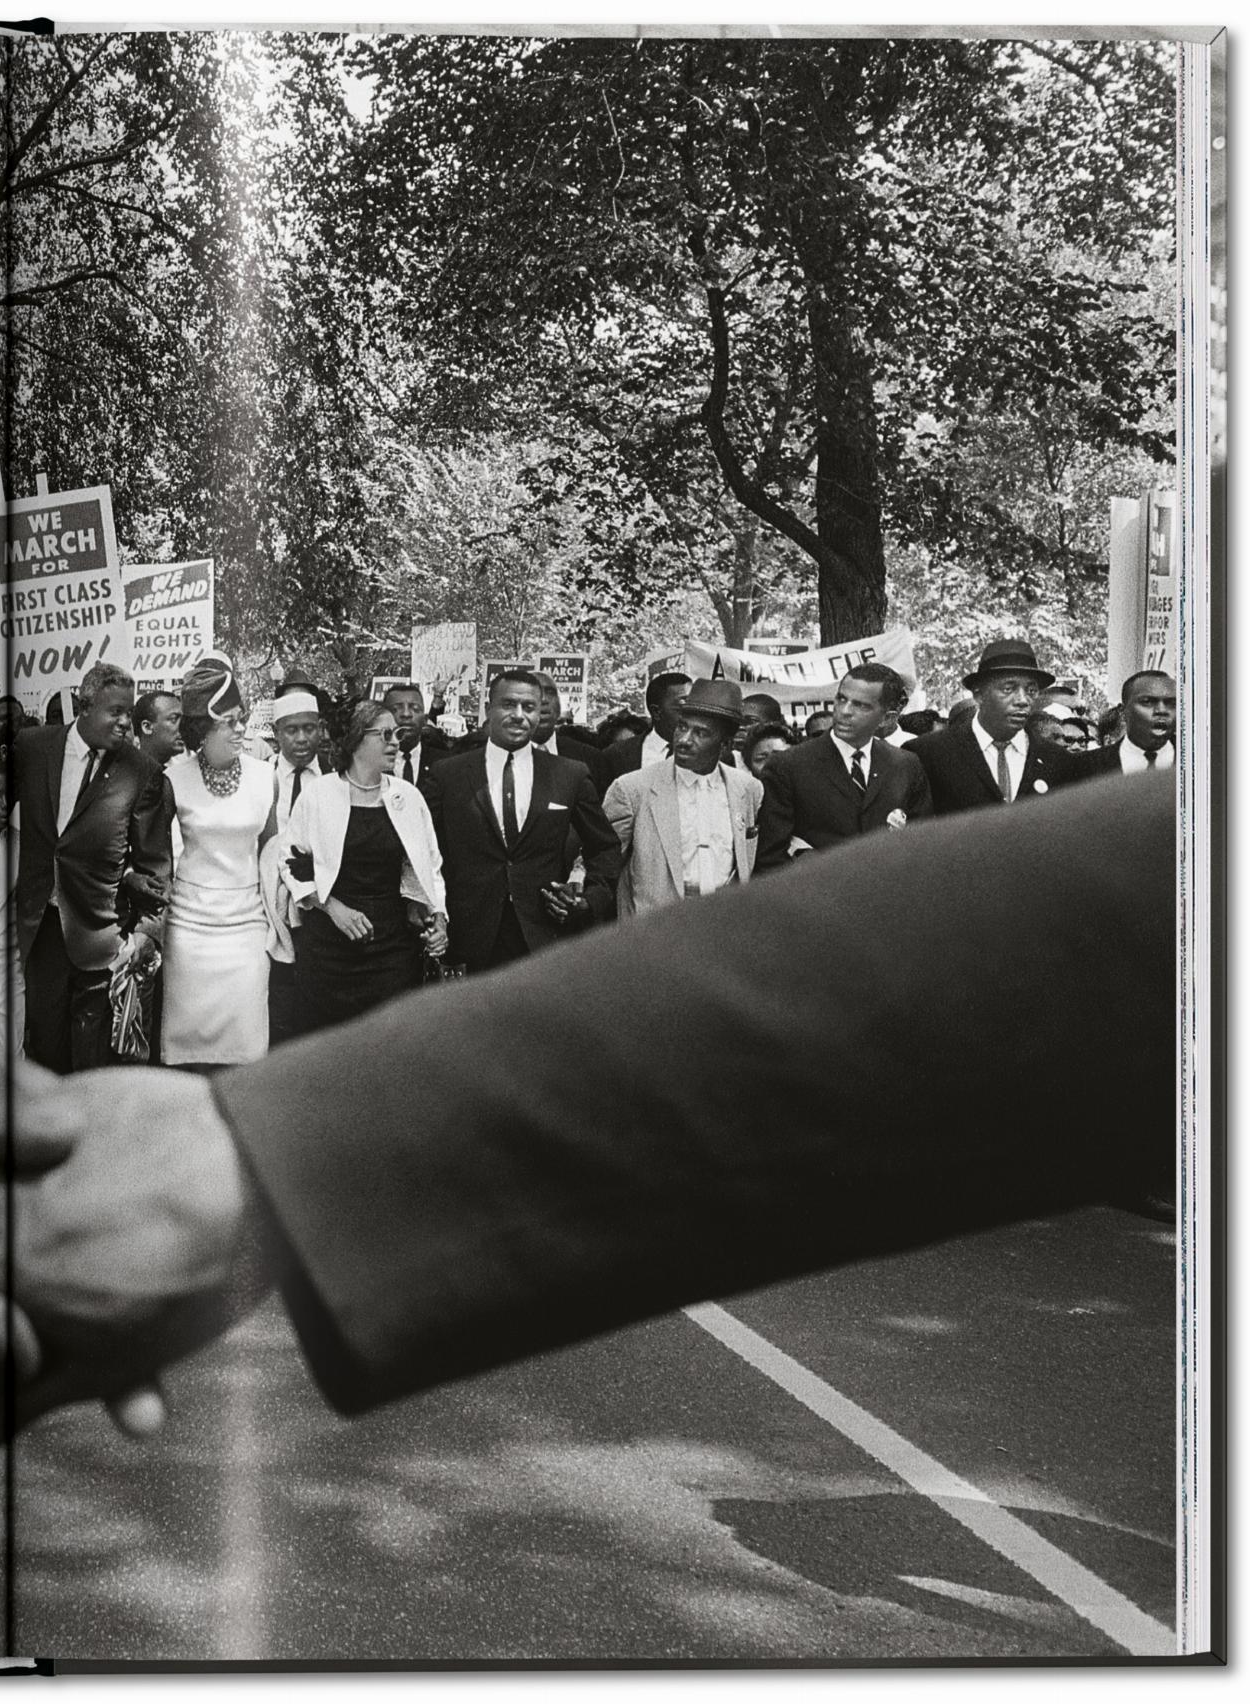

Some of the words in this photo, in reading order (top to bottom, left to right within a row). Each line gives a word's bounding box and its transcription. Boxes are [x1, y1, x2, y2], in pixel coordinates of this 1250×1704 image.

[27, 511, 62, 534] WE
[3, 528, 97, 565] MARCH
[31, 559, 70, 575] FOR
[151, 570, 185, 593] WE
[1, 588, 48, 614] FIRST
[54, 578, 112, 606] CLASS
[128, 579, 209, 616] DEMAND
[0, 603, 117, 640] CITIZENSHIP
[136, 615, 200, 632] EQUAL
[133, 633, 203, 649] RIGHTS
[768, 646, 787, 656] WE
[14, 634, 111, 680] NOW!
[132, 648, 204, 672] NOW!
[555, 659, 569, 667] WE
[711, 653, 726, 681] A
